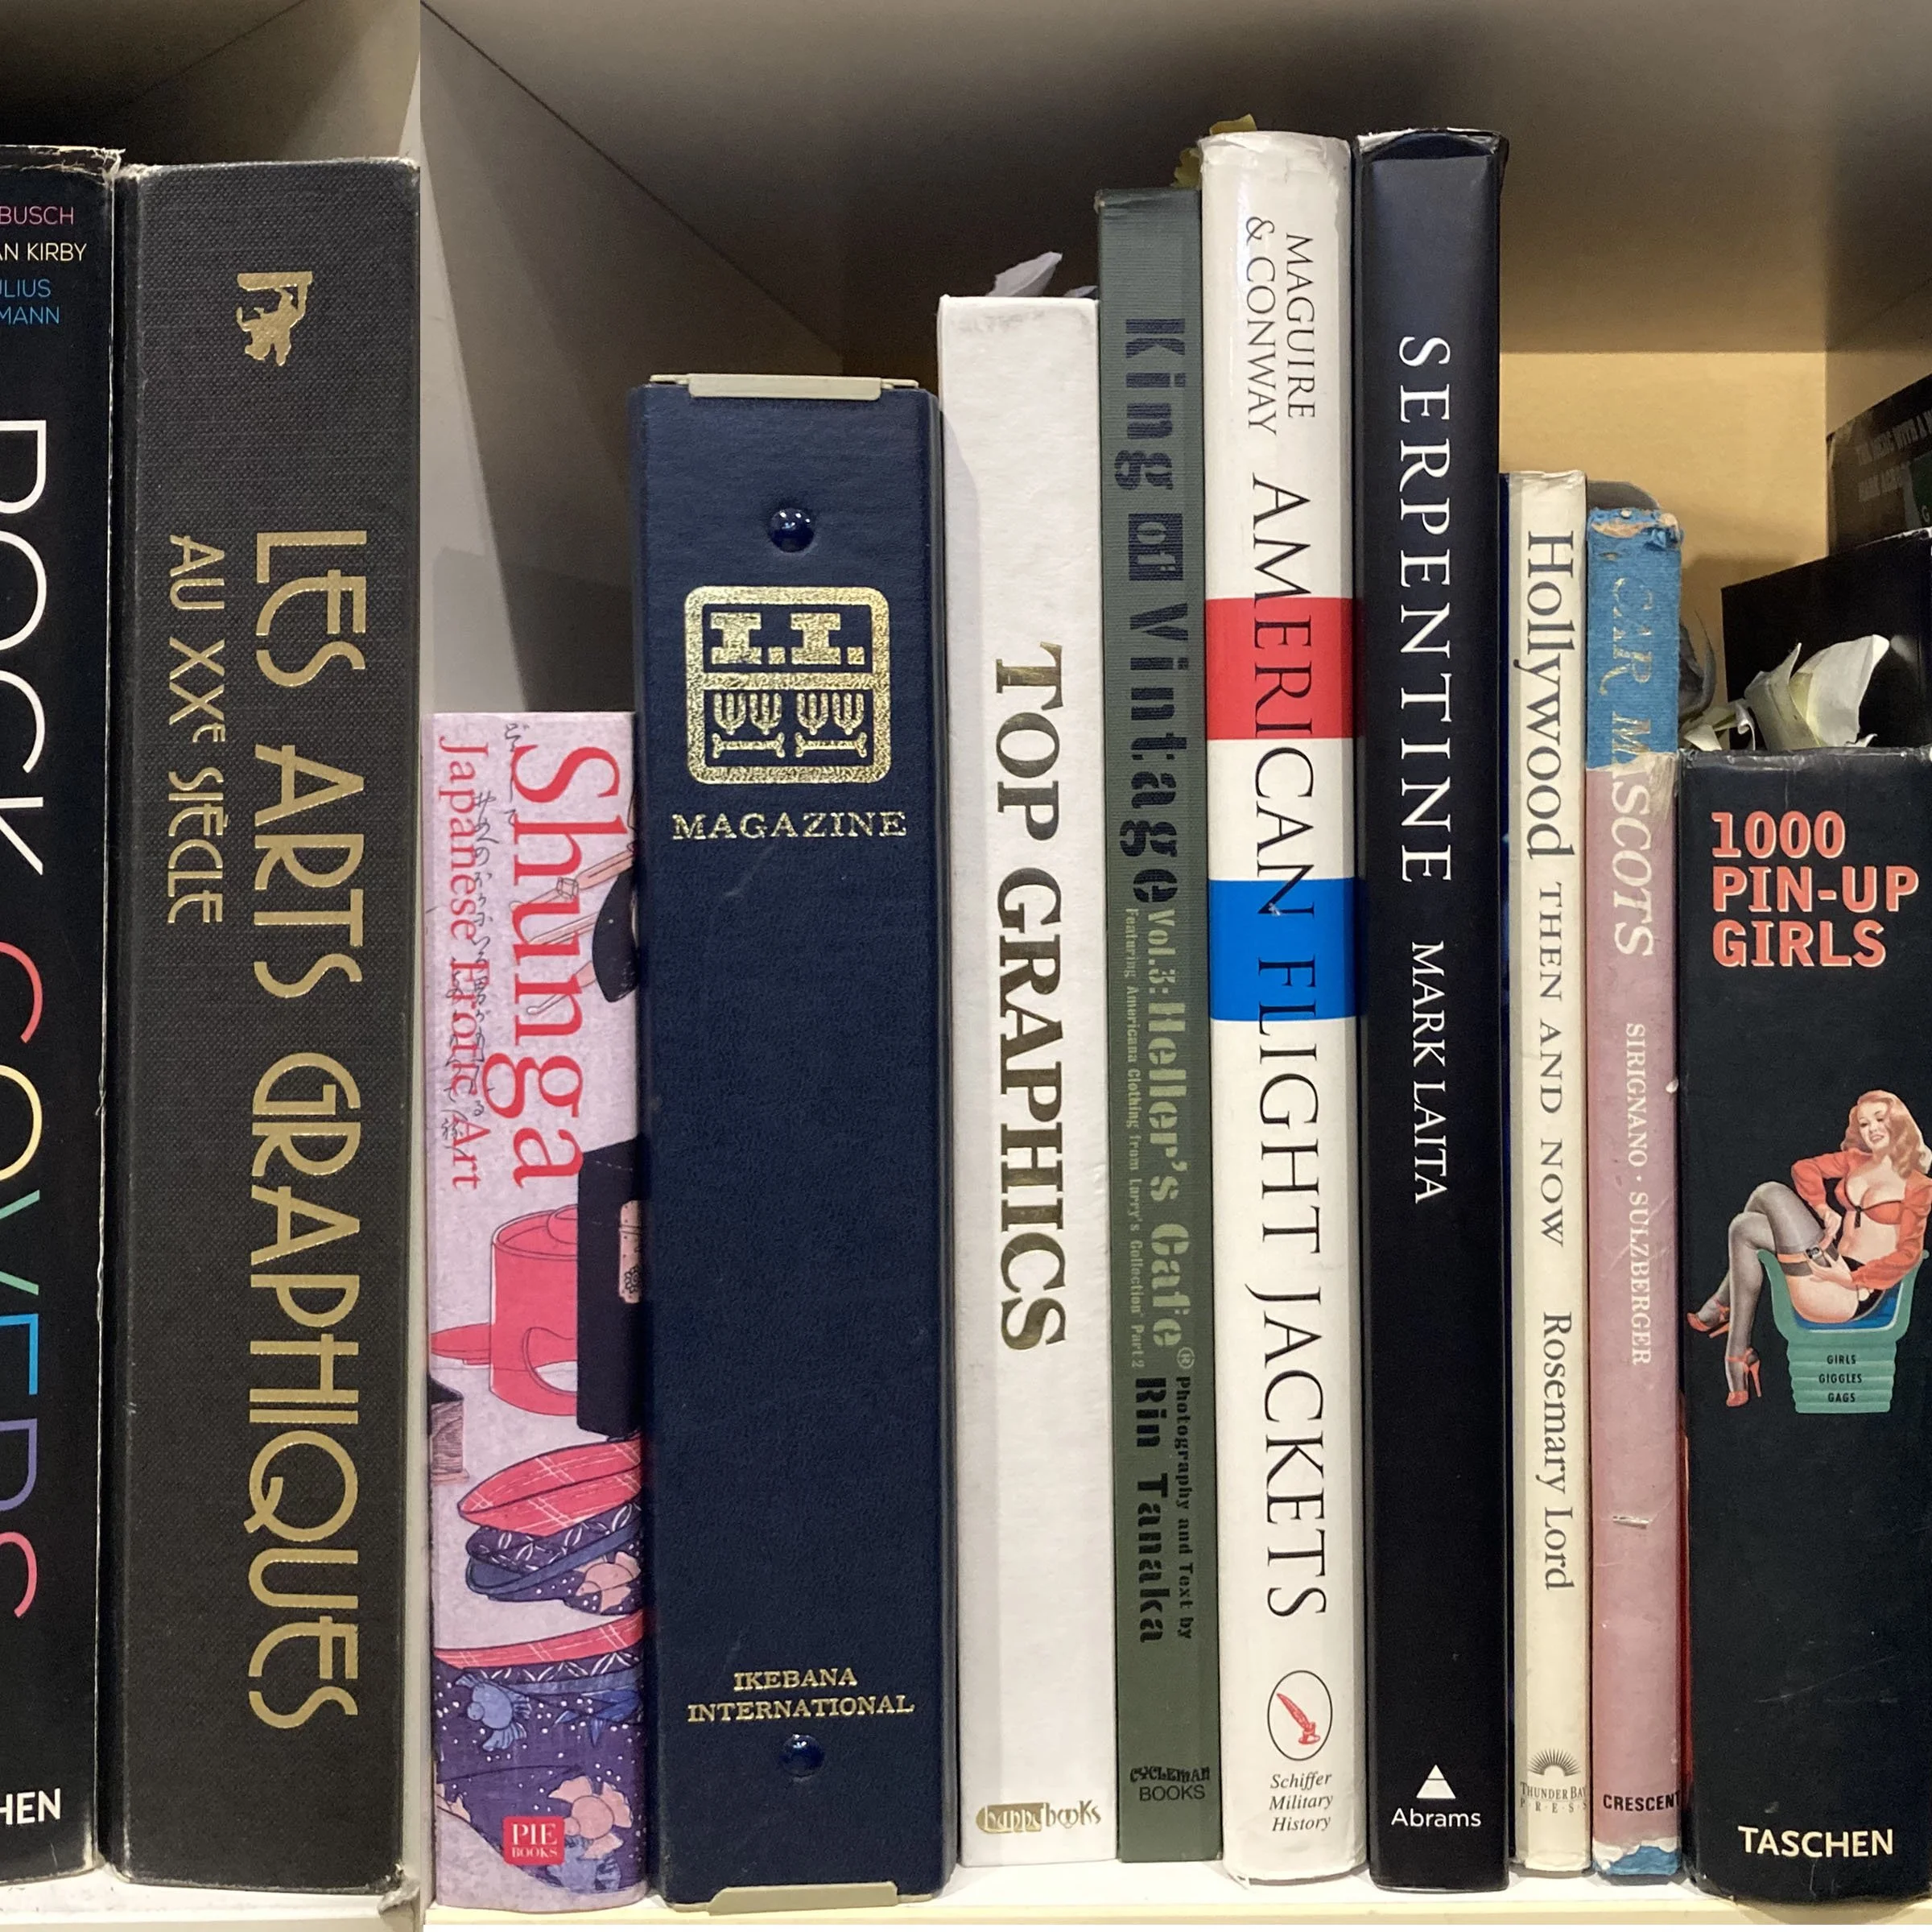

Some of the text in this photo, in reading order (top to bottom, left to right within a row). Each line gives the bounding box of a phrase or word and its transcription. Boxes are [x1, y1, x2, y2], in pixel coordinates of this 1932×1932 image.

[0, 206, 74, 225] BUSCH
[0, 242, 87, 262] N KIRBY
[0, 279, 52, 298] LIUS
[1245, 216, 1276, 436] & CONWAY
[1284, 233, 1315, 419] MAGUIRE
[168, 535, 225, 610] AU
[1113, 318, 1188, 903] King of Vintage
[1397, 336, 1451, 1204] SERPENTINE MARK LAITA
[167, 767, 228, 924] SIÈCLE
[436, 736, 489, 941] Japanese
[671, 811, 907, 840] MAGAZINE
[1711, 811, 1846, 859] 1000
[1712, 865, 1919, 913] PIN-UP
[481, 743, 628, 1189] Shunga
[1123, 908, 1139, 978] Featuring
[1712, 919, 1887, 968] GIRLS
[994, 643, 1066, 1352] TOP GRAPHICS
[449, 960, 489, 1098] Erotic
[1126, 986, 1140, 1063] Americana
[1243, 473, 1326, 1619] AMERICAN FLIGHT JACKETS
[1512, 530, 1575, 1591] Hollywood THEN AND NOW Rosemary Lord
[1125, 1068, 1141, 1129] Clothing
[1147, 1002, 1188, 1202] Heller's
[242, 530, 366, 1730] LES ARTS GRAPHIQUES
[450, 1116, 490, 1190] Art
[1128, 1134, 1141, 1170] from
[1126, 1179, 1142, 1232] Larry's
[1624, 1022, 1652, 1367] SIRIGNANO SULZBERGER
[1818, 1373, 1863, 1384] GIGGLES
[1826, 1354, 1856, 1364] GIRLS
[1827, 1393, 1856, 1402] GAGS
[1134, 1377, 1170, 1643] Rin Tanaka
[1174, 1376, 1194, 1640] Photography and Text by
[733, 1667, 857, 1691] IKEBANA
[687, 1695, 915, 1723] INTERNATIONAL
[1140, 1784, 1205, 1802] BOOKS
[1269, 1771, 1332, 1790] Schiffer
[1269, 1794, 1333, 1810] Military
[1520, 1781, 1568, 1799] THUNDER
[1603, 1790, 1681, 1812] CRESCENT
[512, 1823, 558, 1845] PIE
[1272, 1816, 1331, 1831] History
[1391, 1808, 1481, 1827] Abrams
[1737, 1826, 1893, 1858] TASCHEN
[512, 1847, 557, 1859] BOOKS
